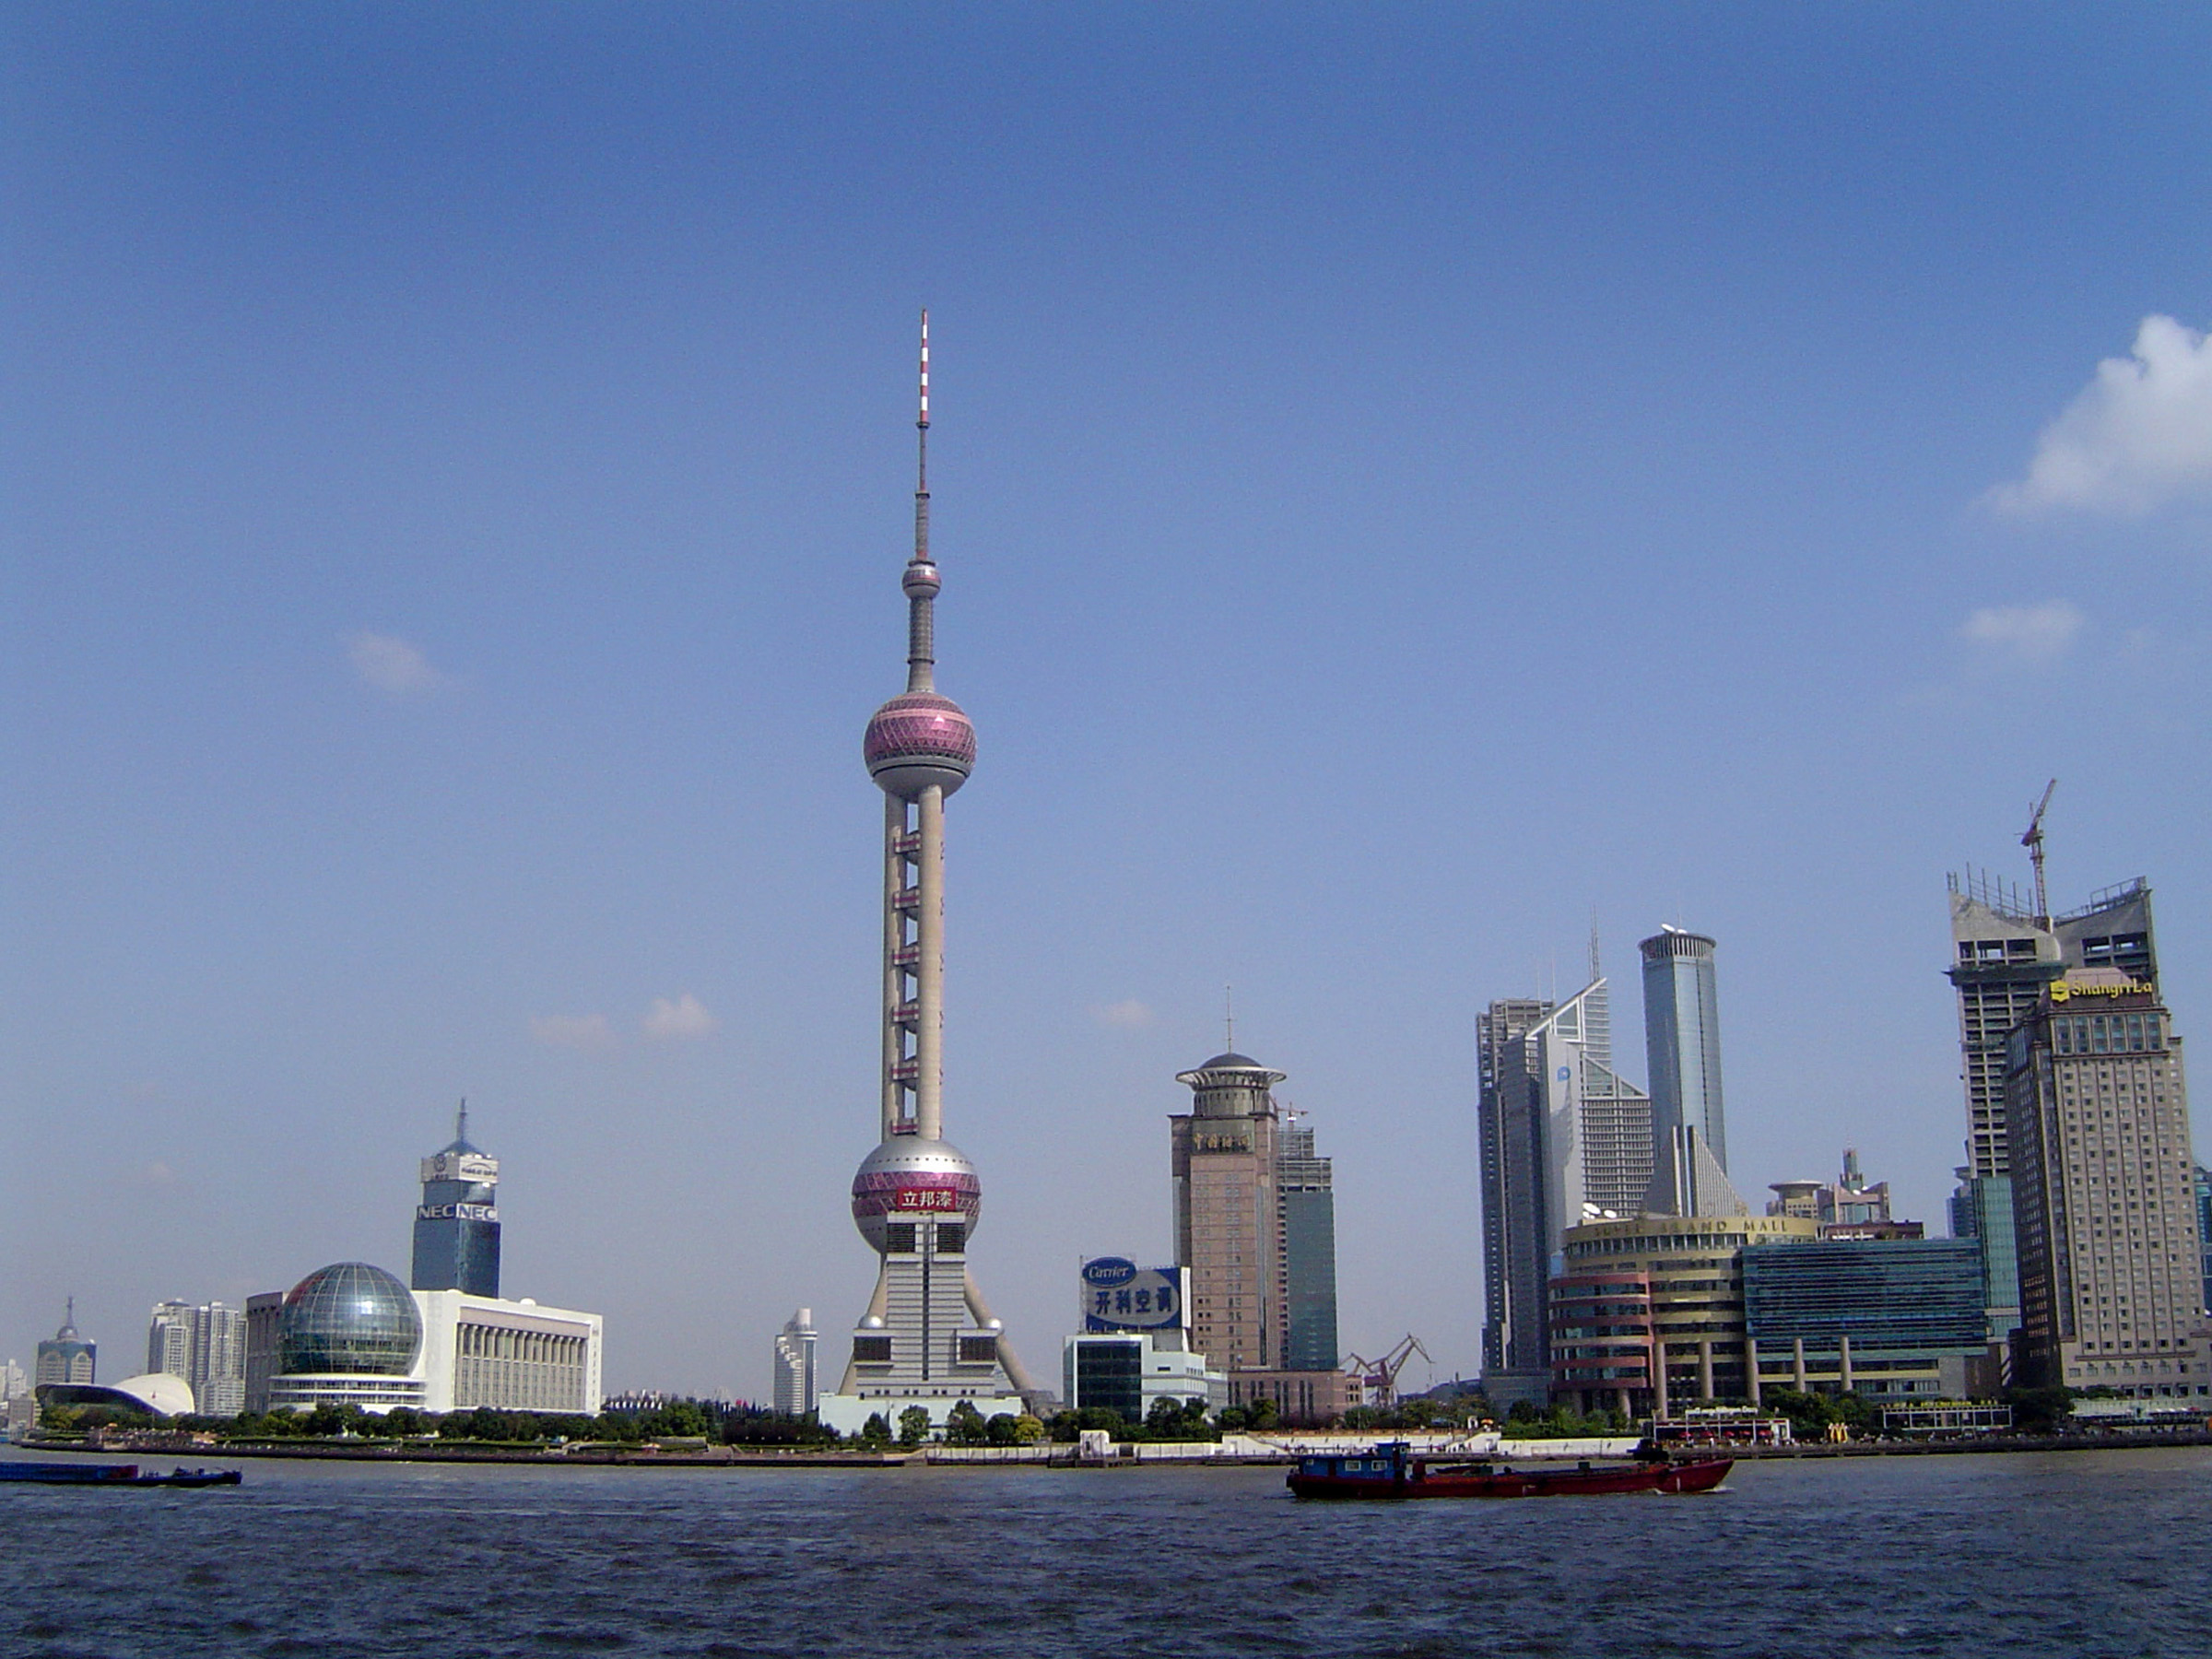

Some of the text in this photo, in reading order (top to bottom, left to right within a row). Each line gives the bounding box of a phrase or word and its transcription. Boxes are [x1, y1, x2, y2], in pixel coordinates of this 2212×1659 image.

[901, 1190, 952, 1207] 立邦漆
[418, 1205, 455, 1218] NEC
[459, 1206, 497, 1220] NEC
[1743, 1219, 1787, 1232] MALL
[1088, 1265, 1129, 1279] Carrier
[1095, 1286, 1172, 1314] 开利空调
